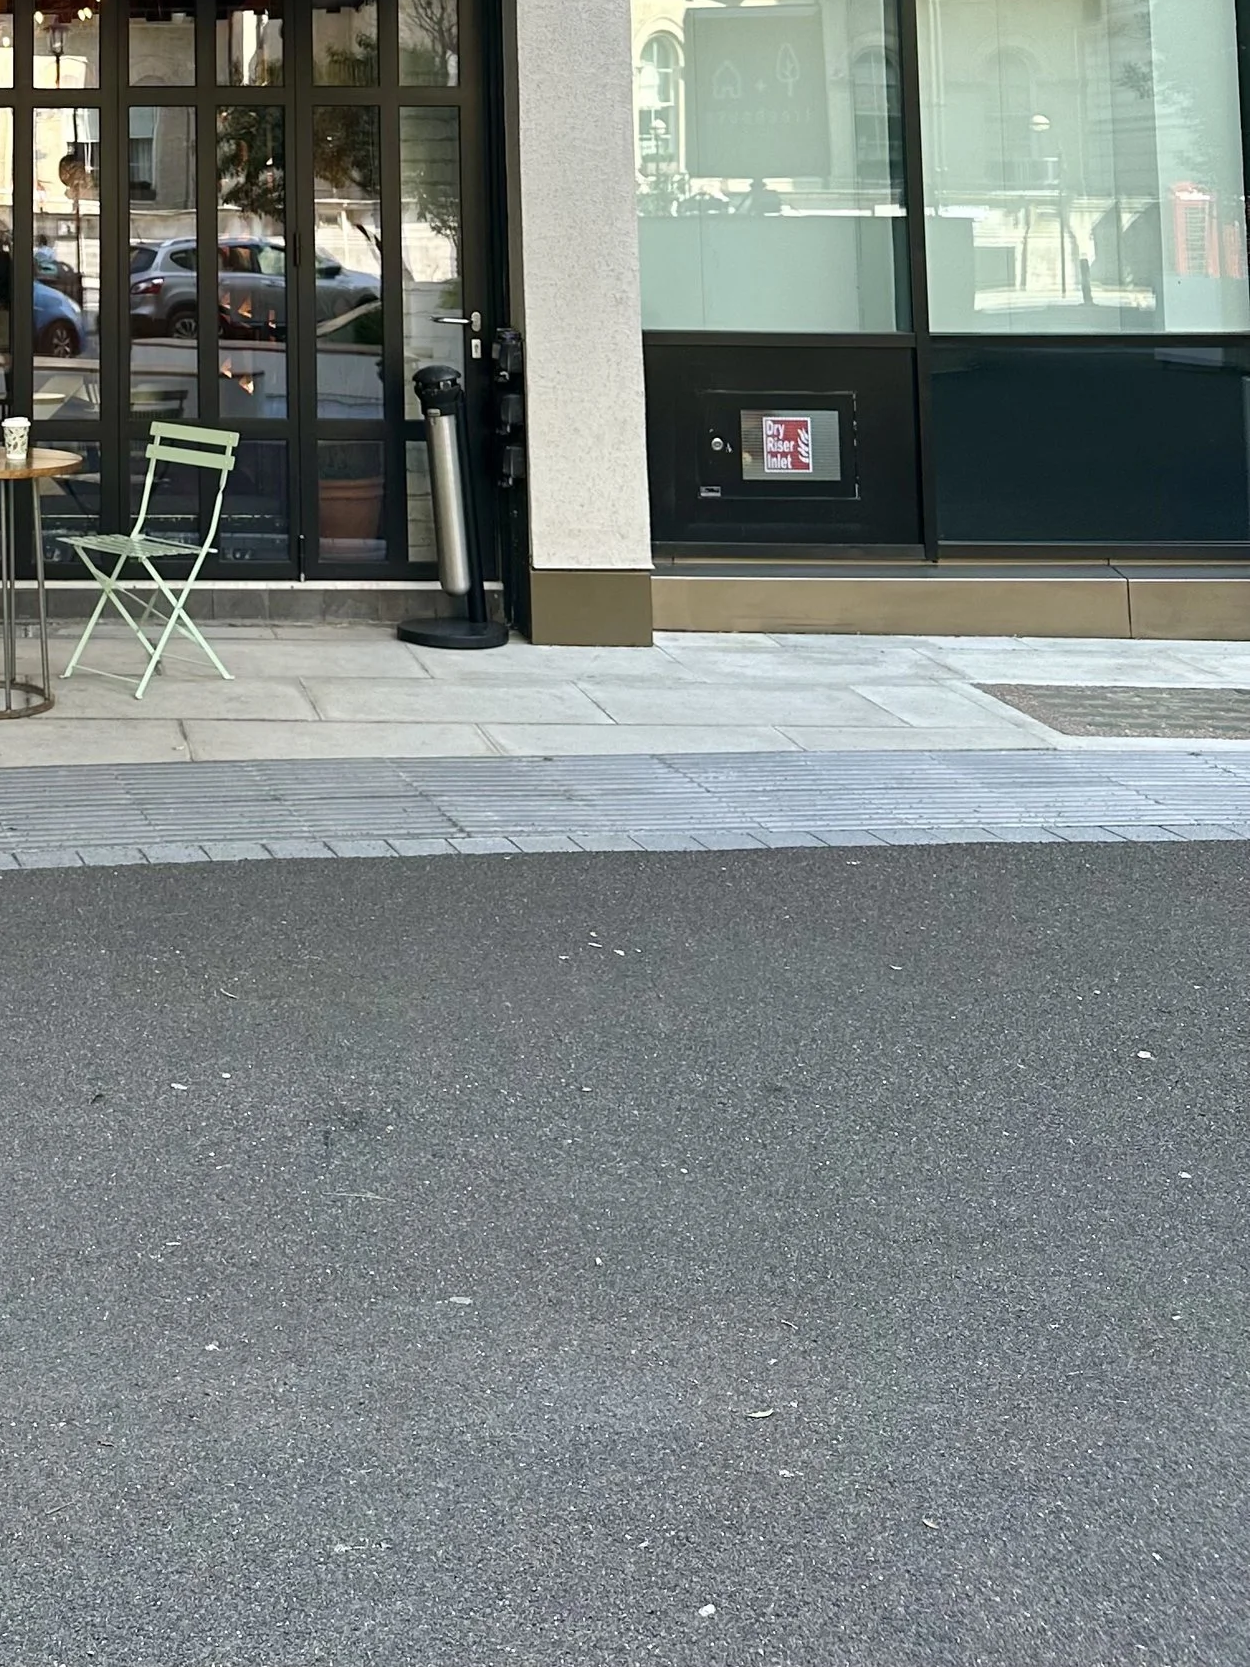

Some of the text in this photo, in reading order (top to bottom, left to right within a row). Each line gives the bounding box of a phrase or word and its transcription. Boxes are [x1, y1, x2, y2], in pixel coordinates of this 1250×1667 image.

[766, 420, 785, 440] Dry
[766, 437, 795, 452] Riser
[767, 453, 793, 469] Inlet
